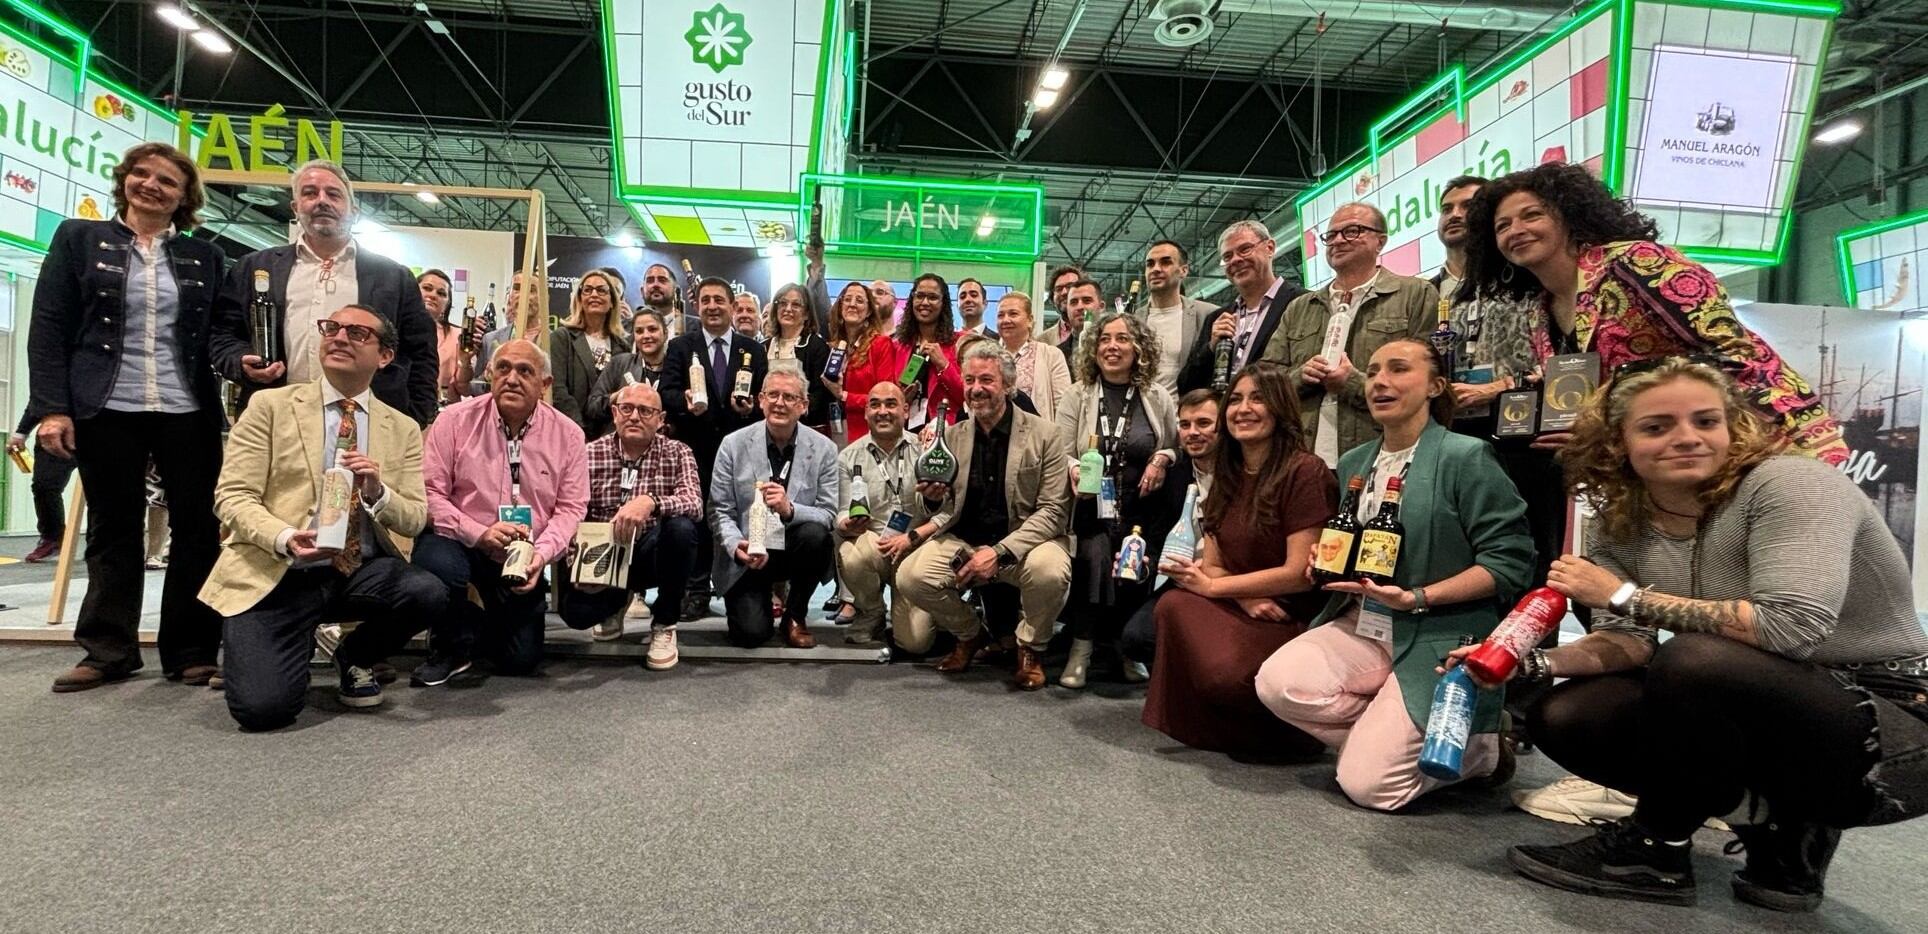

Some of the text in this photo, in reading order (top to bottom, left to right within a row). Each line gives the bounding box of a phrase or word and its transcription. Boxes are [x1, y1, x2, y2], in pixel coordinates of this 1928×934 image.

[683, 78, 752, 108] gusto
[687, 101, 751, 126] del Sur
[1661, 138, 1760, 157] MANUEL ARAGÓN
[1671, 156, 1745, 168] VINOS DE CHICLANA
[881, 195, 959, 232] JAÉN
